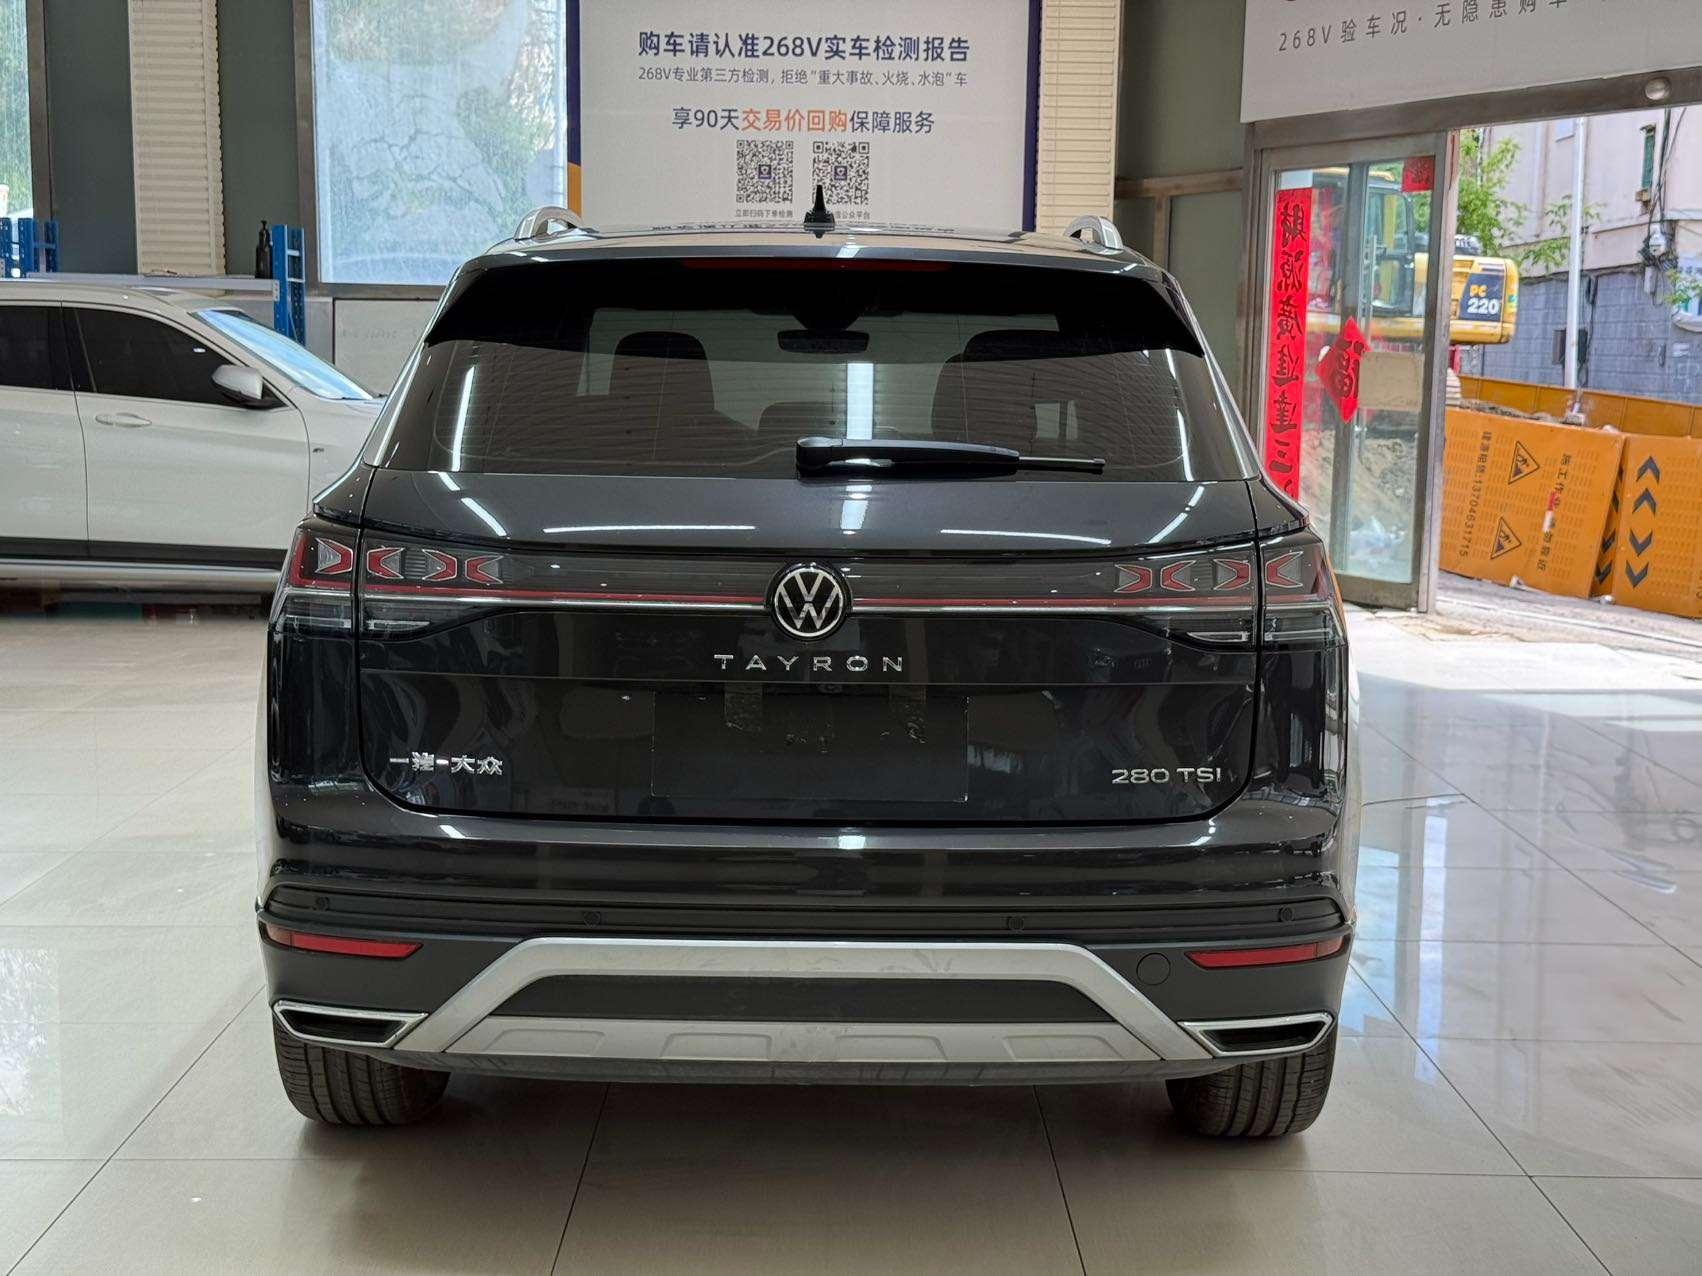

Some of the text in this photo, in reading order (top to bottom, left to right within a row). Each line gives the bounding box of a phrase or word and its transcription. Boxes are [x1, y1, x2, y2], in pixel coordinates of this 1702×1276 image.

[638, 31, 970, 62] 购车请认准268V实车检测报告
[672, 106, 935, 134] 享90天交易价回购保障服务
[1470, 285, 1487, 297] PC
[1467, 298, 1499, 315] 220
[714, 654, 902, 671] TAYRON
[1111, 766, 1221, 784] 280 TSI
